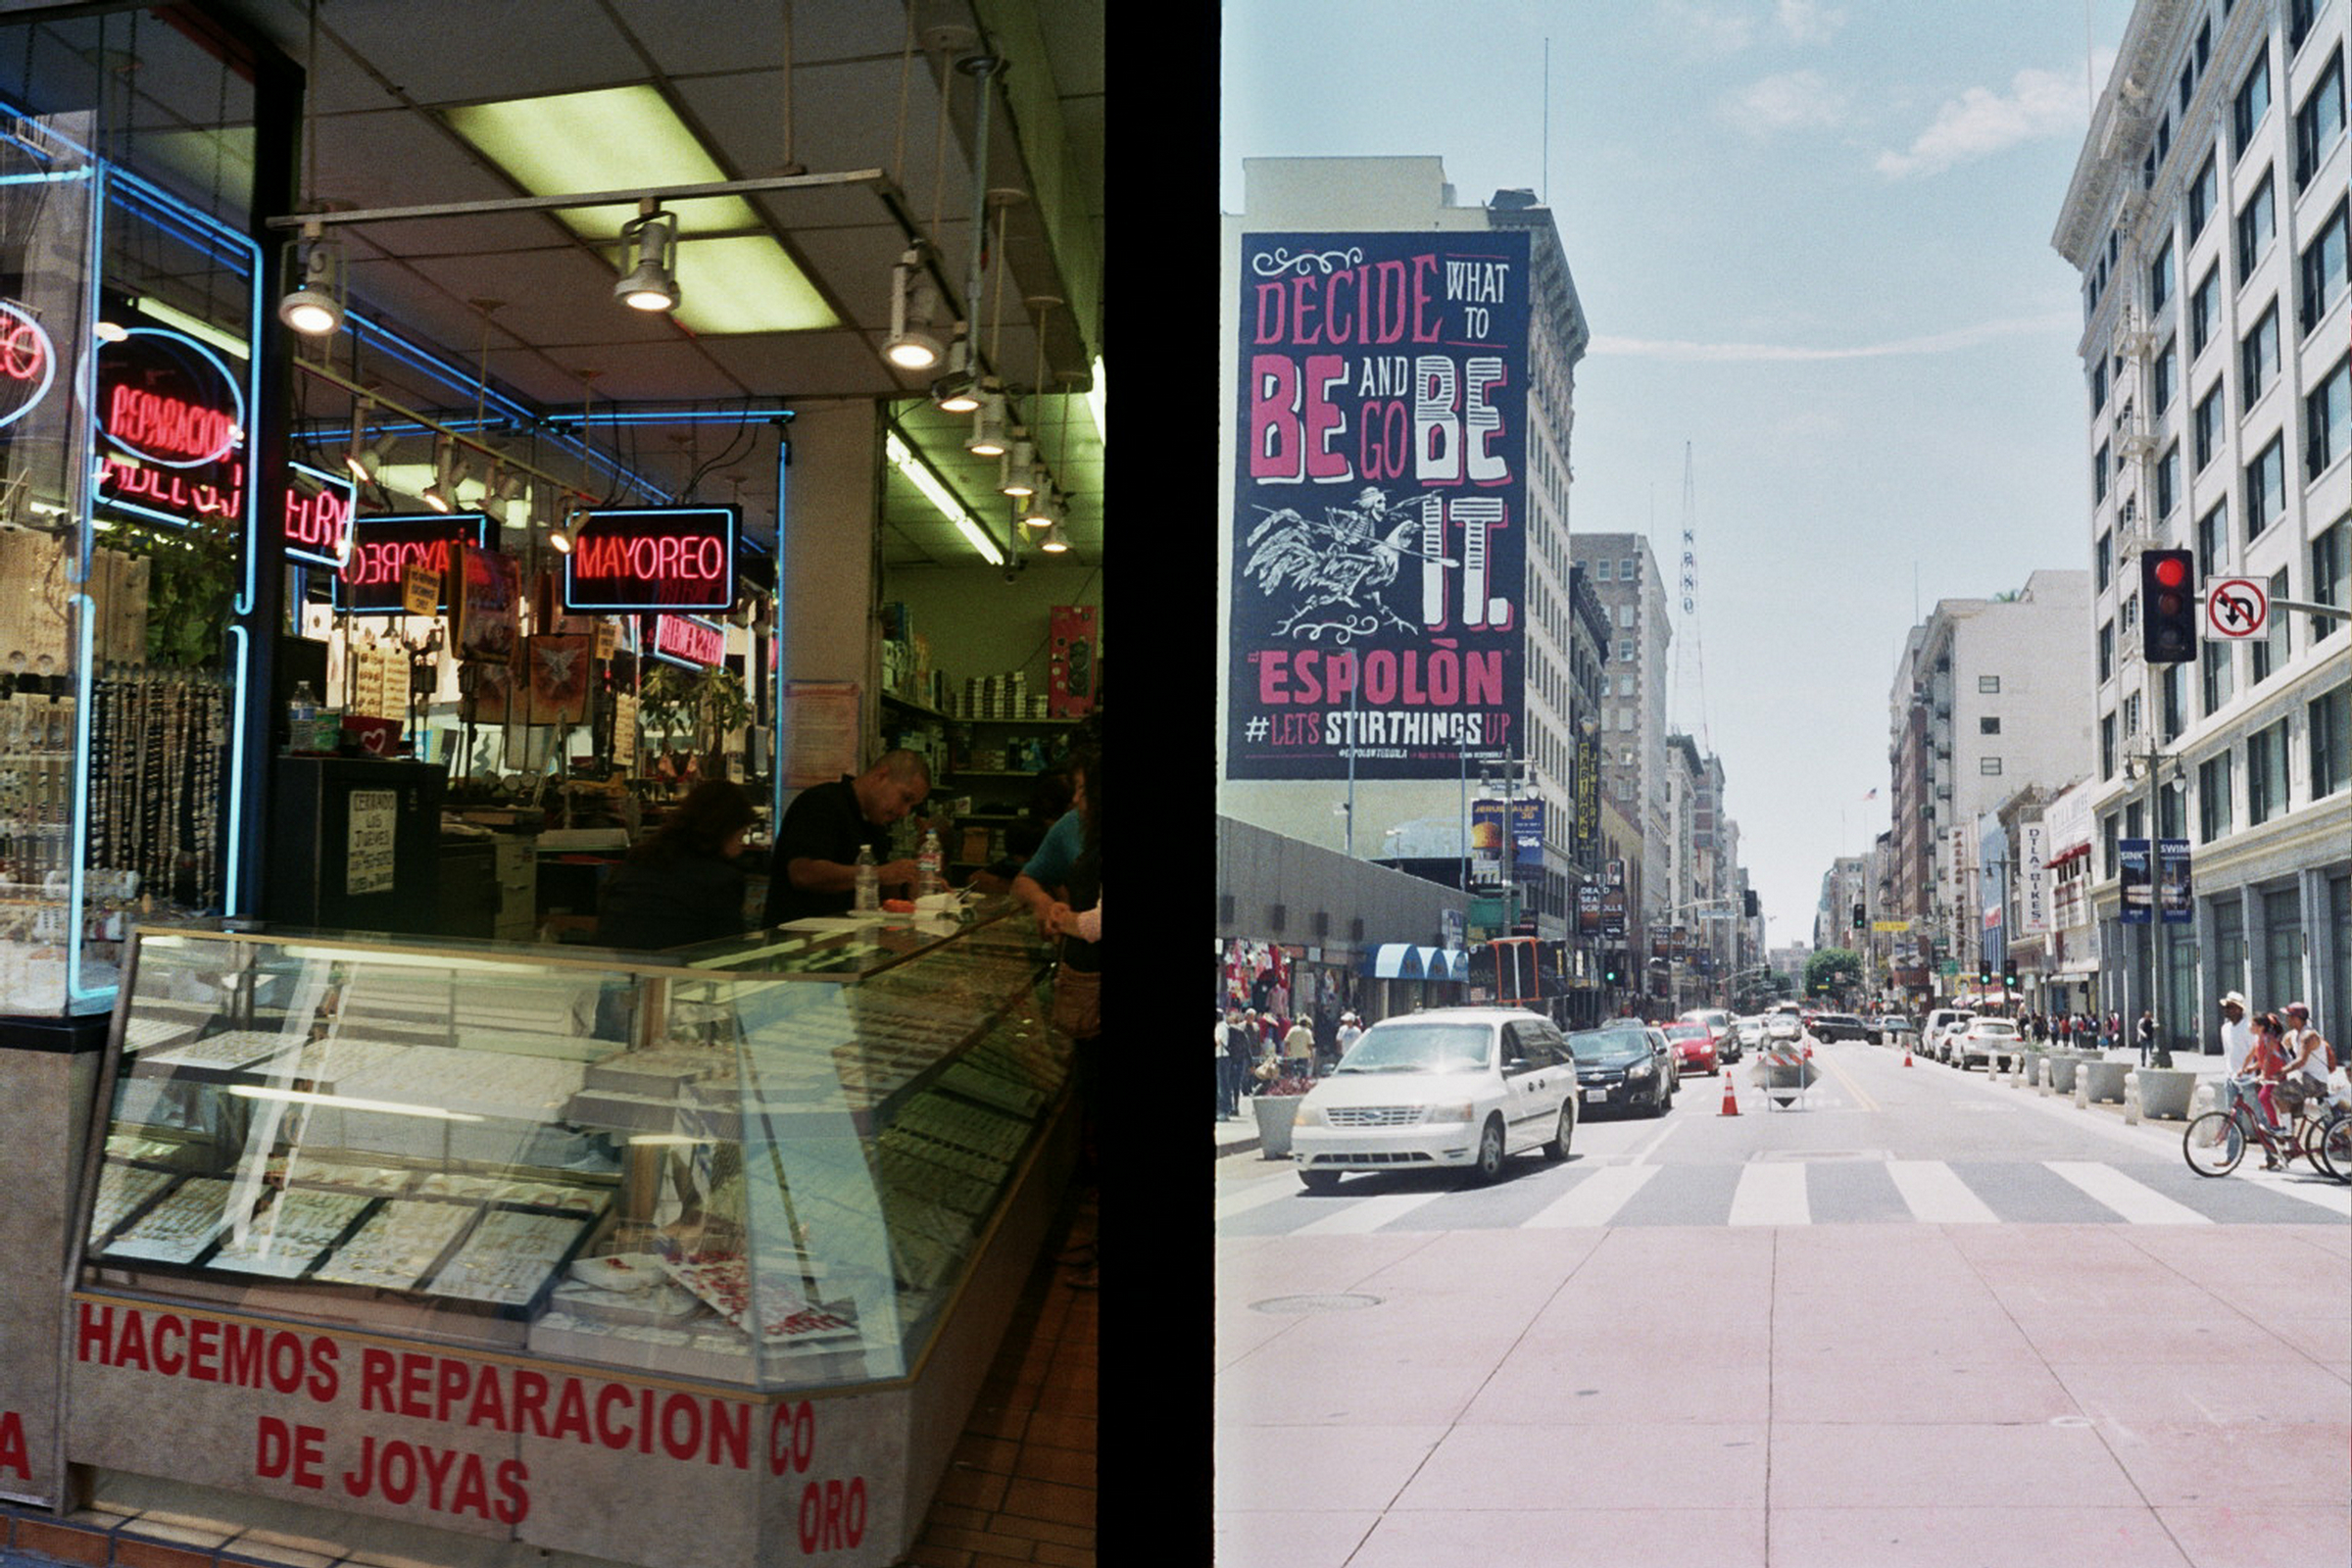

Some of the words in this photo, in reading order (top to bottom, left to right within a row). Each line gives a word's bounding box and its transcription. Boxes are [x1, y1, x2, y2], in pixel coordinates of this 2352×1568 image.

[1254, 254, 1443, 345] DECIDE
[1446, 261, 1509, 303] WHAT
[1465, 307, 1490, 339] TO
[1358, 356, 1408, 397] AND
[1250, 354, 1354, 485] BE
[1360, 400, 1408, 480] GO
[1415, 355, 1512, 487] BE
[576, 534, 723, 580] MAYOREO
[1486, 712, 1510, 745] UP
[2031, 873, 2041, 919] BIKES
[77, 1302, 340, 1403] HACEMOS
[360, 1348, 751, 1470] REPARACION
[768, 1399, 814, 1477] CO
[256, 1415, 327, 1491] DE
[343, 1436, 530, 1525] JOYAS
[799, 1476, 866, 1555] ORO
